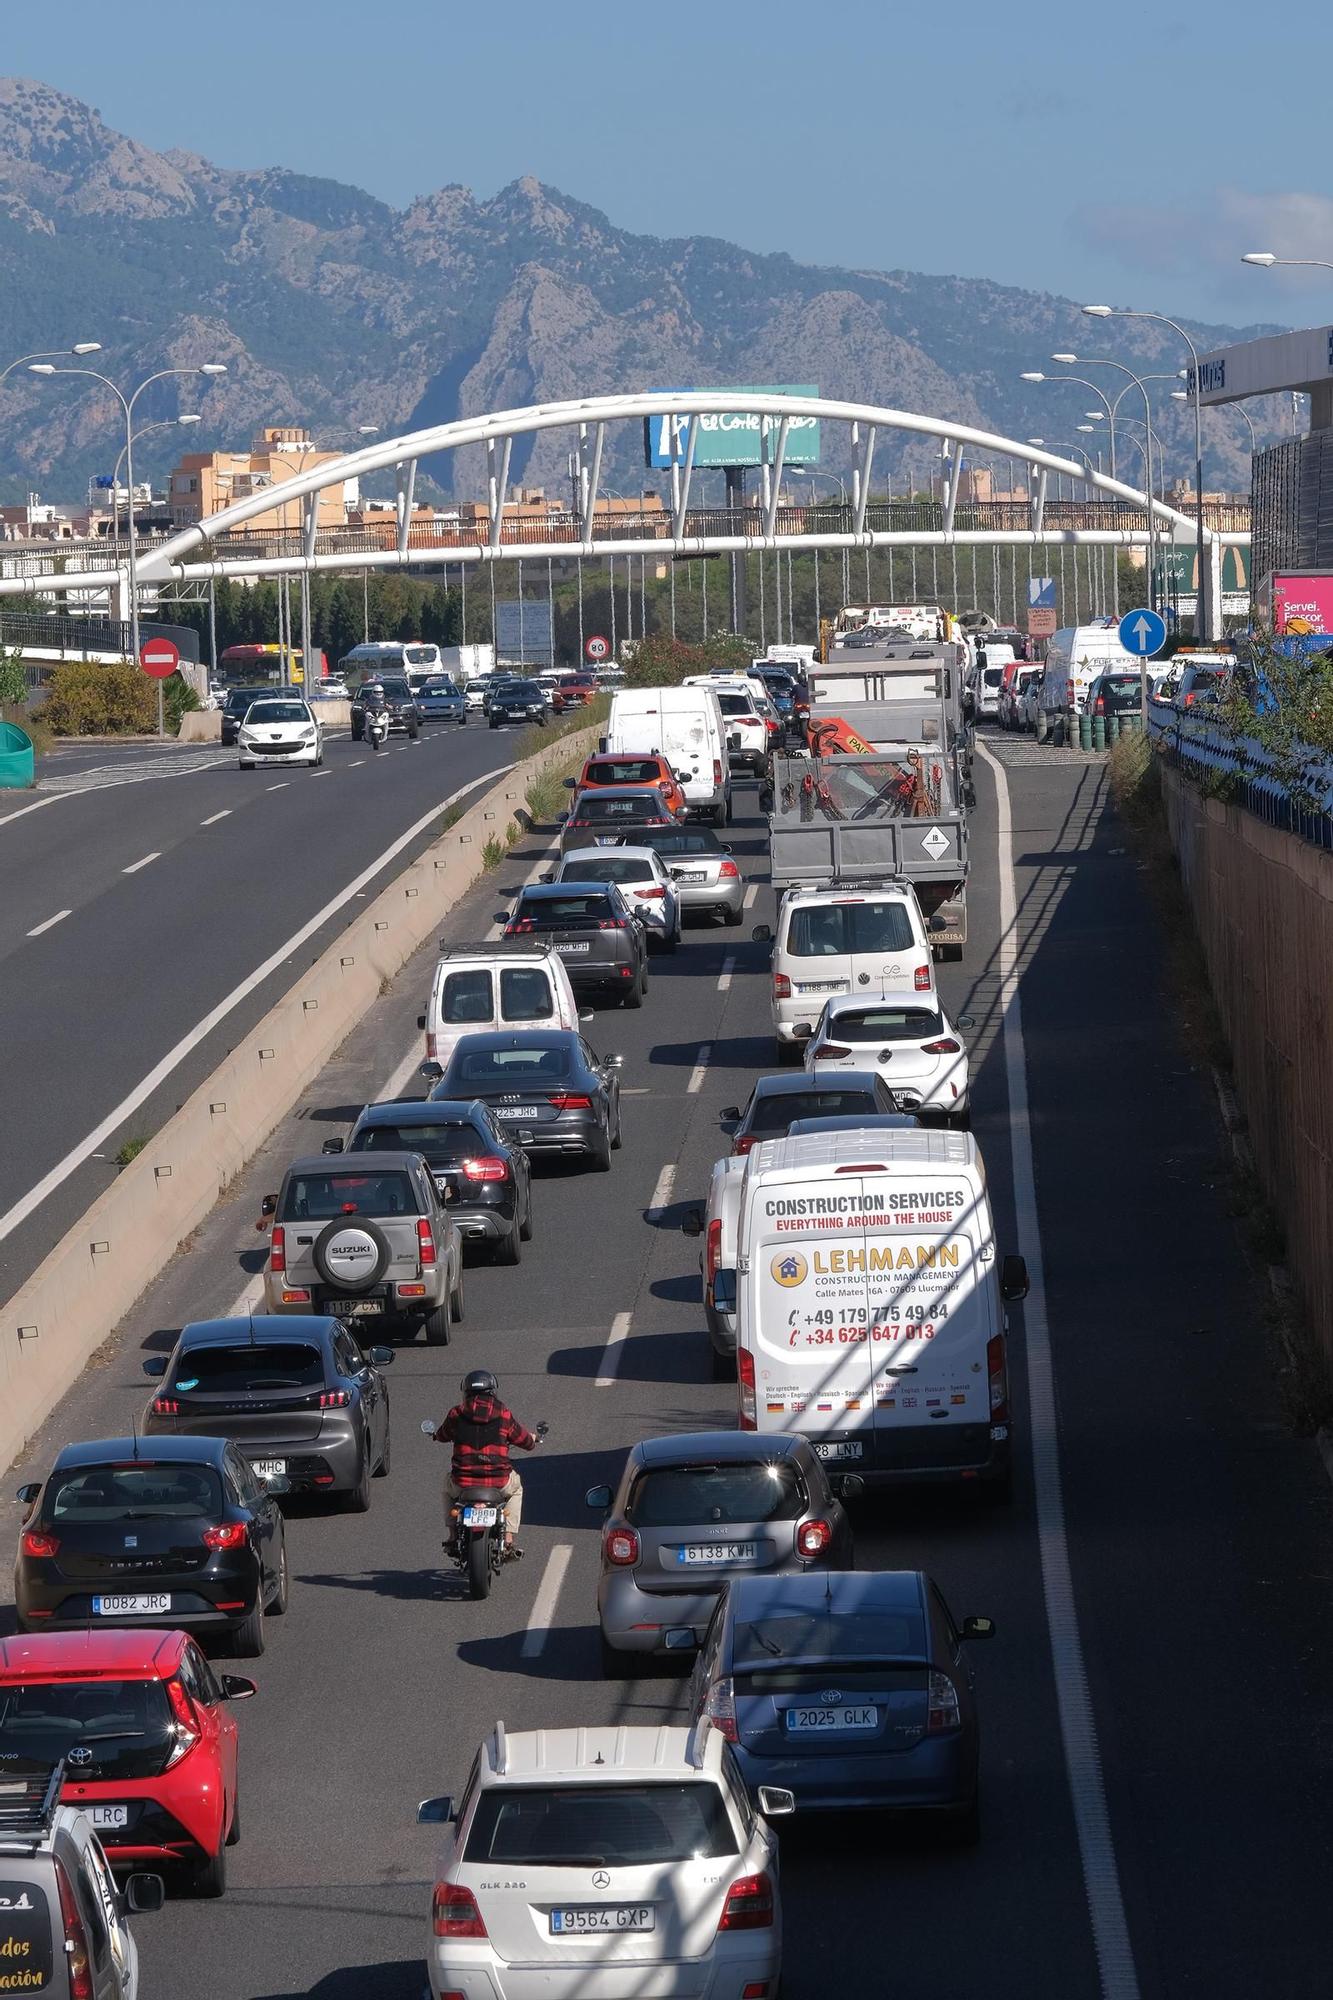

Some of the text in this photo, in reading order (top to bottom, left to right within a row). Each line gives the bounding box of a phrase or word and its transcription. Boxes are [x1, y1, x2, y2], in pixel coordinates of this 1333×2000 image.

[1284, 601, 1320, 611] Servei.
[591, 644, 604, 652] 80
[766, 1190, 964, 1216] CONSTRUCTION SERVICES
[776, 1211, 953, 1231] EVERYTHING AROUND THE HOUSE
[331, 1245, 370, 1254] SUZUKI
[814, 1244, 960, 1274] LEHMANN
[815, 1271, 960, 1286] CONSTRUCTION MANAGEMENT
[816, 1288, 836, 1298] Calle
[838, 1288, 864, 1297] Mates
[868, 1287, 883, 1295] 16A
[804, 1304, 948, 1325] +49 179 775 49 84
[806, 1324, 934, 1344] +34 625 647 013
[836, 1443, 859, 1456] LNY
[259, 1461, 282, 1473] MHC
[688, 1544, 754, 1560] 6138 KWH
[103, 1594, 167, 1610] 0082 JRC
[800, 1710, 871, 1726] 2025 GLK
[94, 1808, 123, 1823] LRC
[564, 1910, 649, 1928] 9564 GXP
